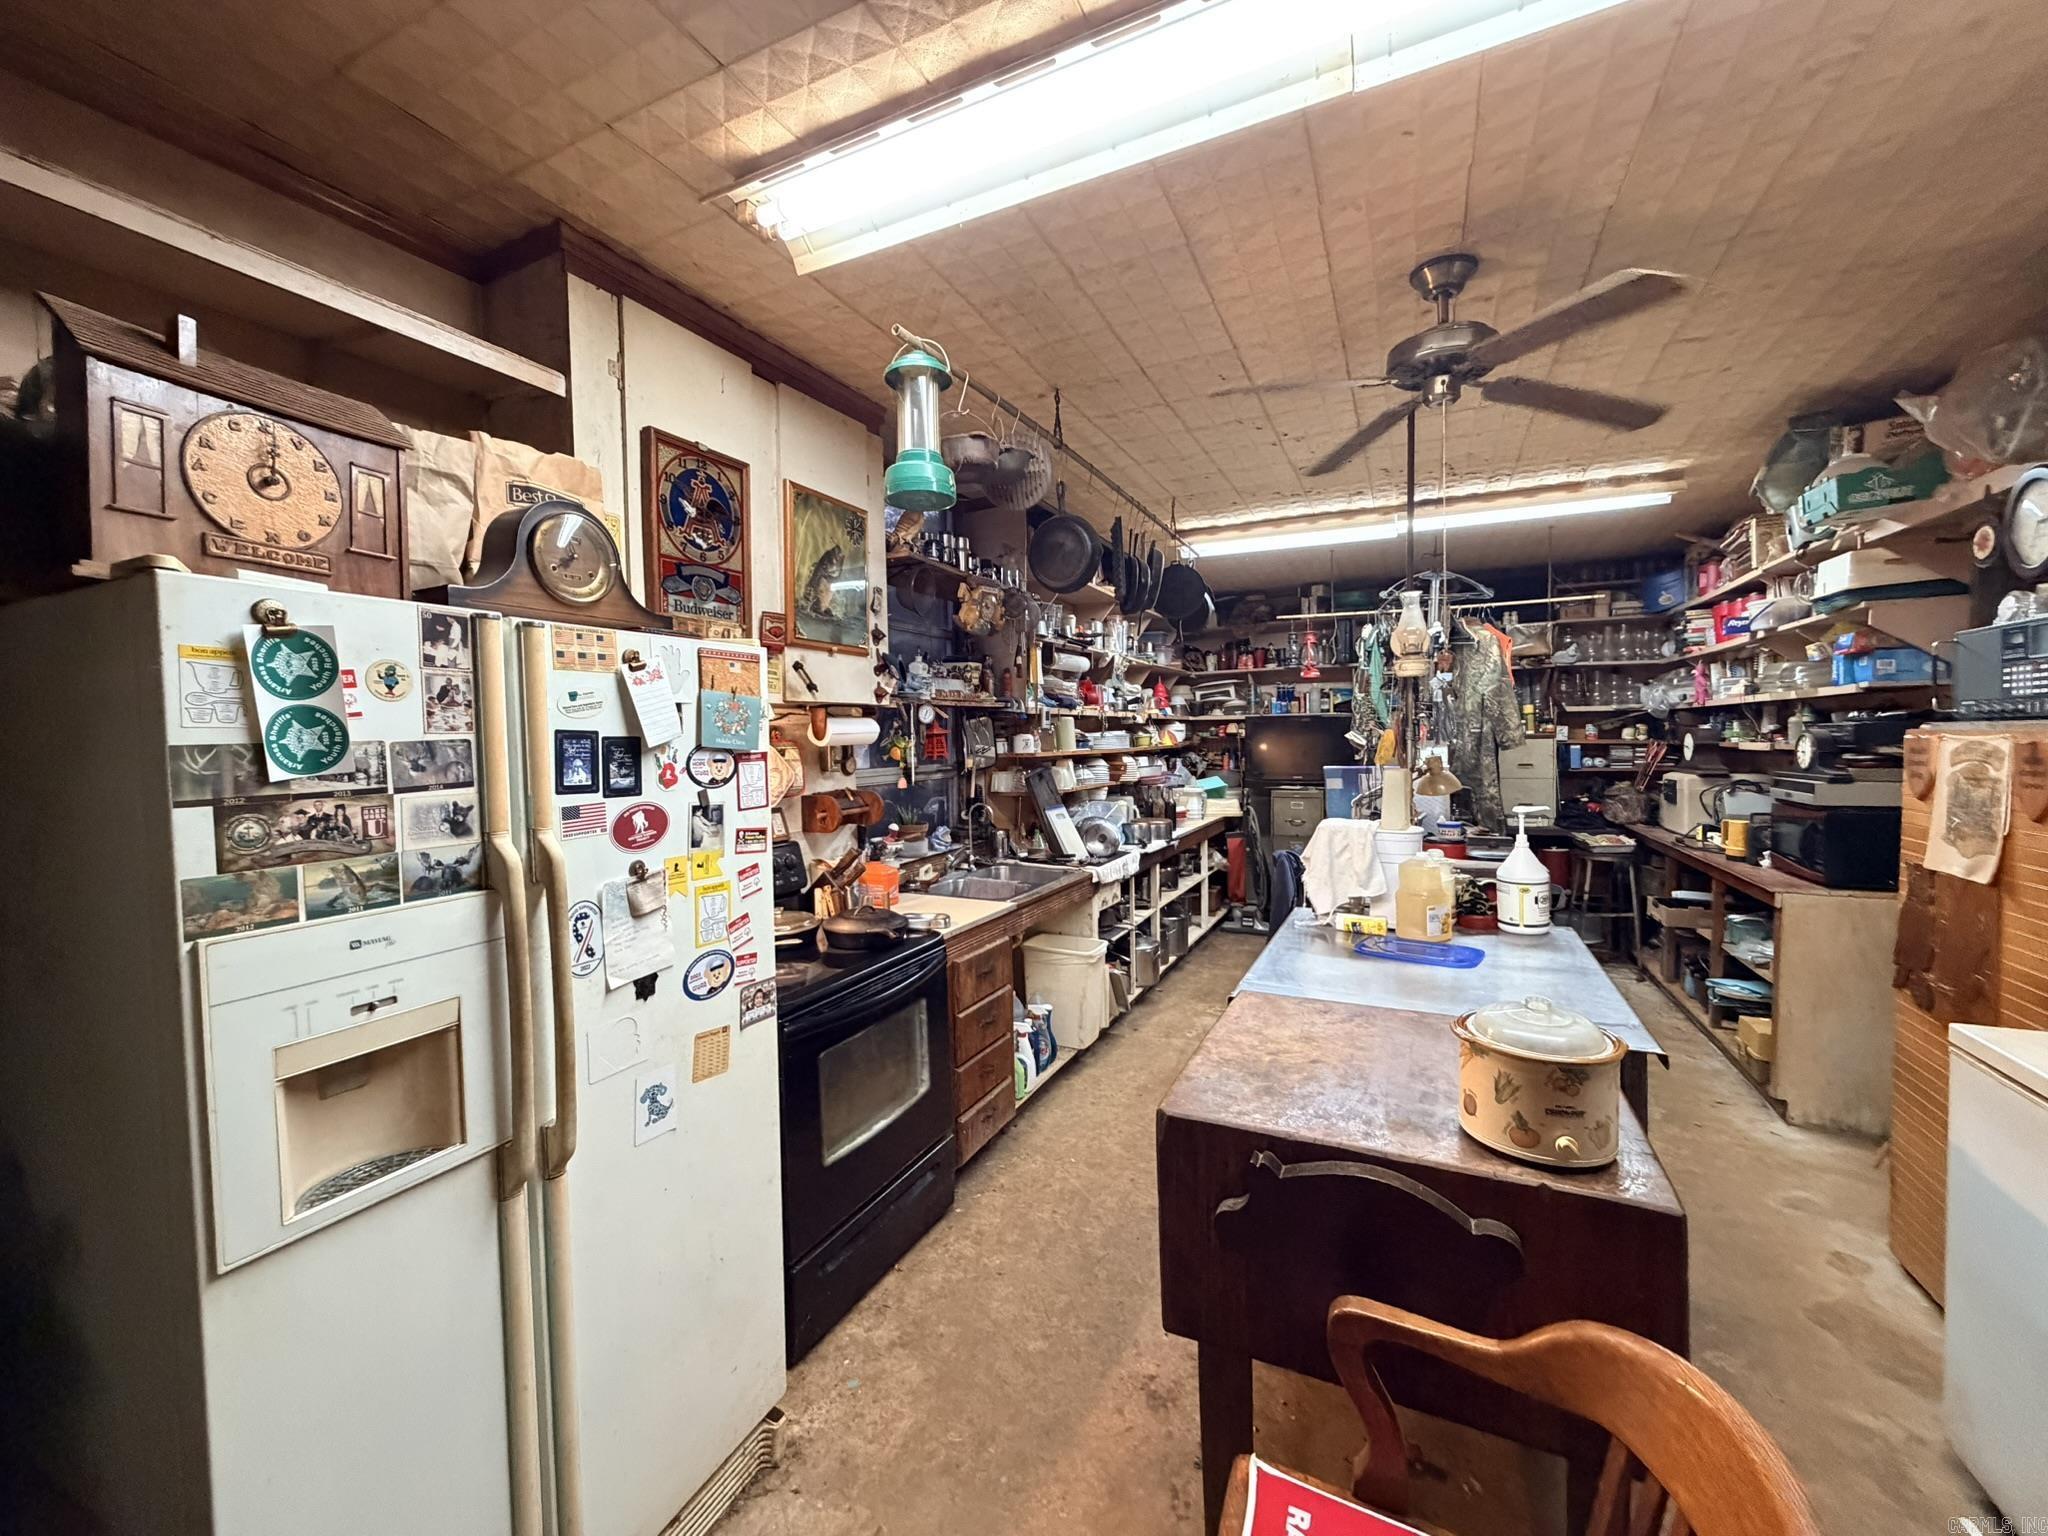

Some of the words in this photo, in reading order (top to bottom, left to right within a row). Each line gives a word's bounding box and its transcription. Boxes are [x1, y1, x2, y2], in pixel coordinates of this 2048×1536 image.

[678, 457, 687, 468] 11
[697, 459, 707, 470] 12
[664, 472, 676, 483] 10
[512, 487, 543, 503] Best
[660, 494, 667, 504] 9
[680, 542, 687, 551] 7
[211, 537, 329, 569] WELCOME
[700, 551, 706, 561] 6
[718, 550, 724, 560] 5
[673, 598, 734, 620] Budweiser
